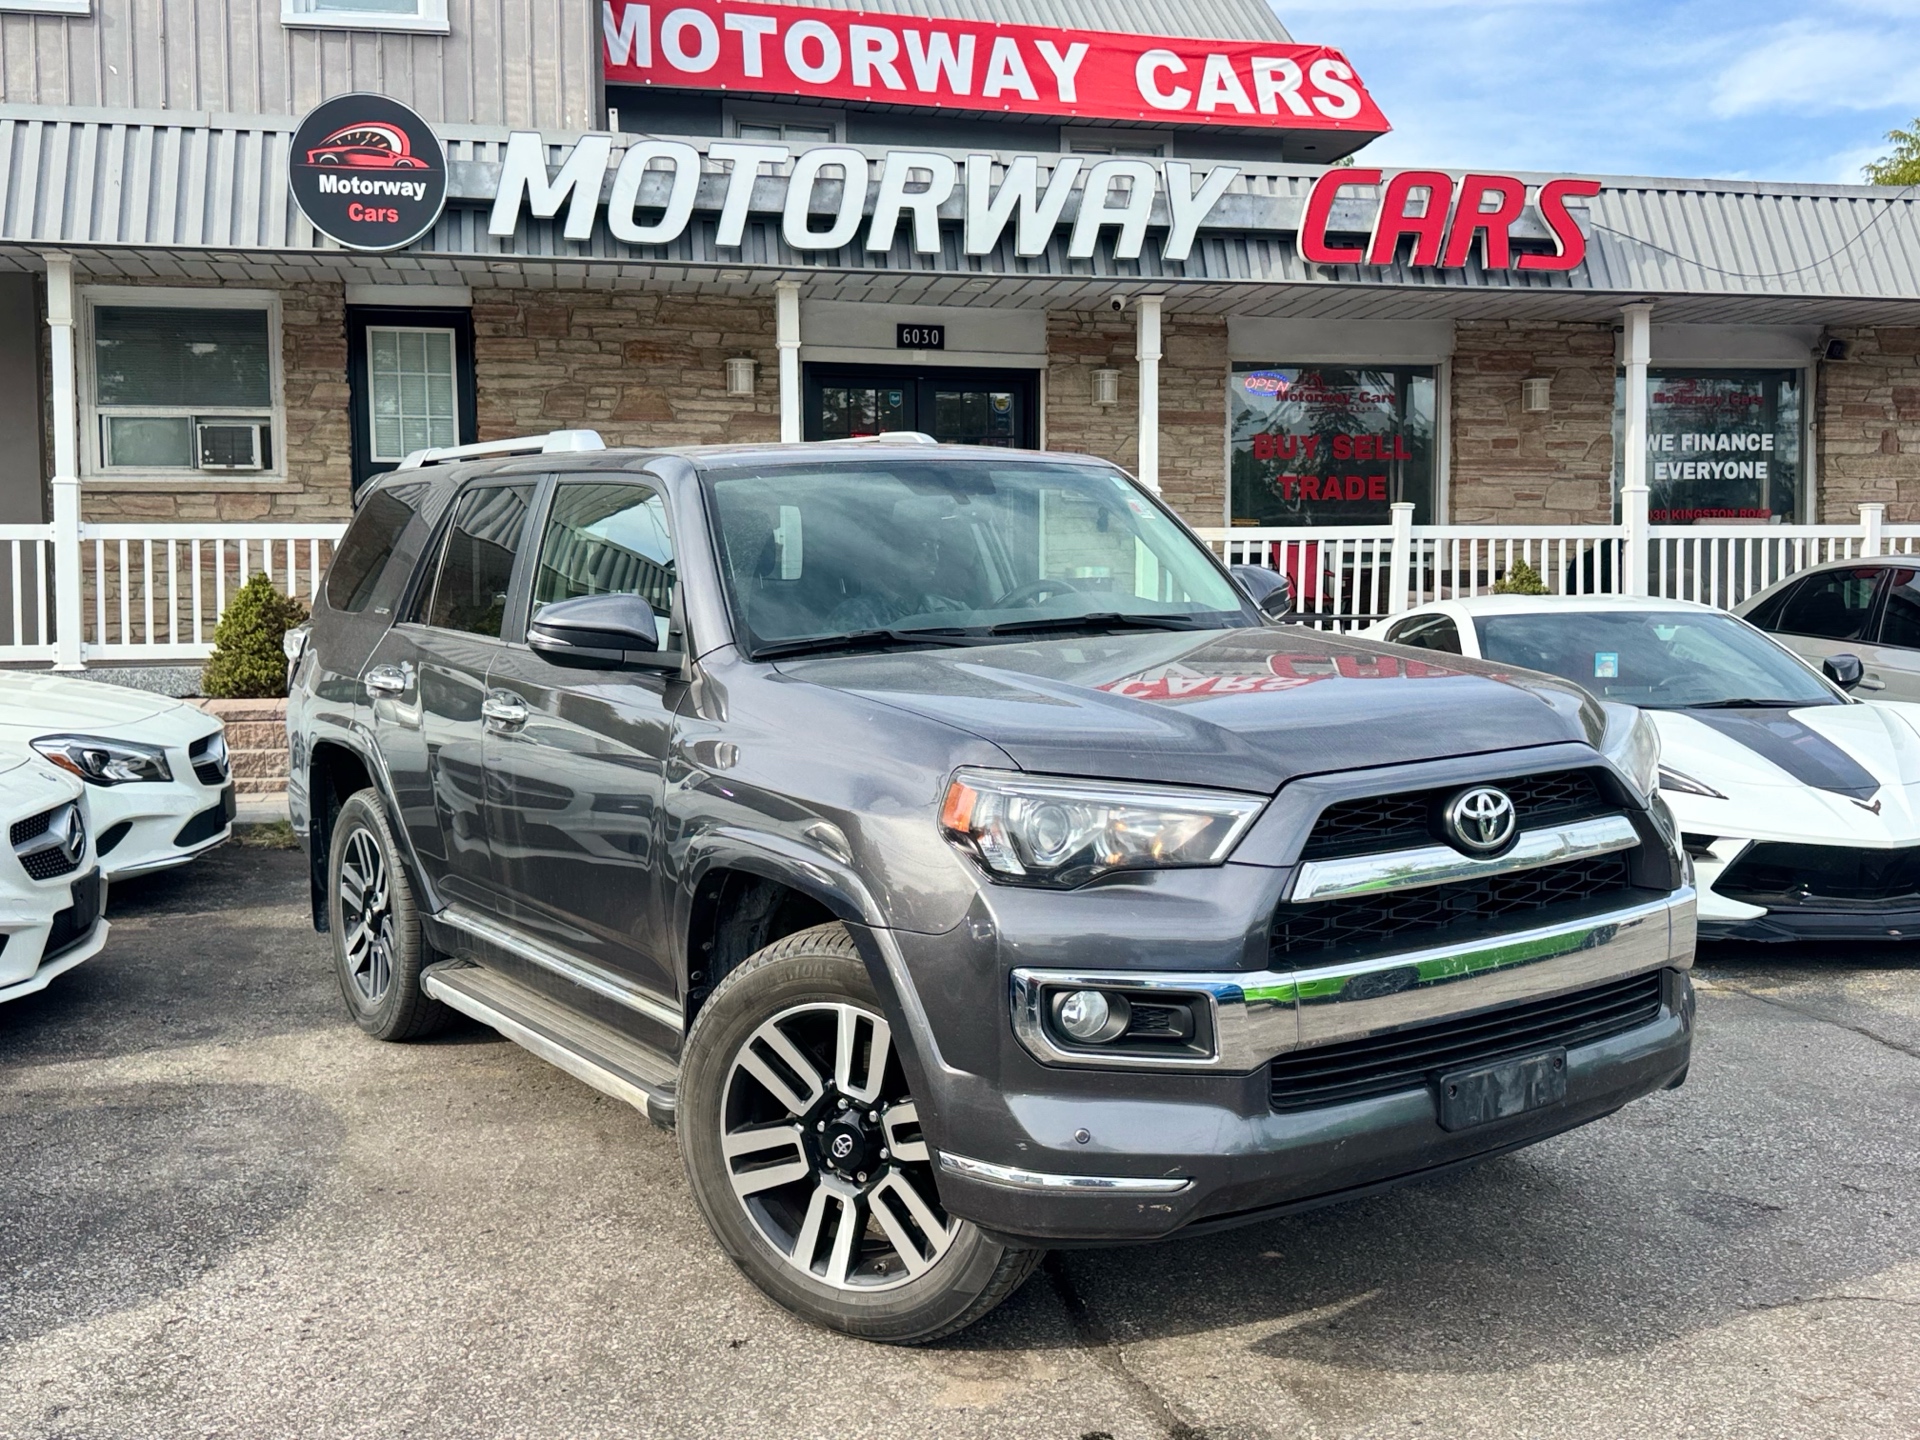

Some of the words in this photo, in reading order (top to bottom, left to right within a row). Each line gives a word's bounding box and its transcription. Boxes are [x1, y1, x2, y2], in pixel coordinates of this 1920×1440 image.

[603, 1, 1090, 104] MOTORWAY
[1135, 48, 1362, 119] CARS
[318, 174, 427, 202] Motorway
[488, 130, 1242, 262] MOTORWAY
[1297, 168, 1602, 271] CARS
[348, 203, 399, 223] Cars
[903, 328, 940, 346] 6030
[1245, 377, 1290, 392] OPEN
[1276, 390, 1350, 405] Motorway
[1359, 391, 1396, 404] Cars
[1254, 434, 1320, 460] BUY
[1332, 434, 1412, 460] SELL
[1647, 433, 1674, 451] WE
[1681, 433, 1774, 451] FINANCE
[1654, 461, 1768, 480] EVERYONE
[1277, 475, 1387, 501] TRADE
[1671, 508, 1736, 520] KINGSTON
